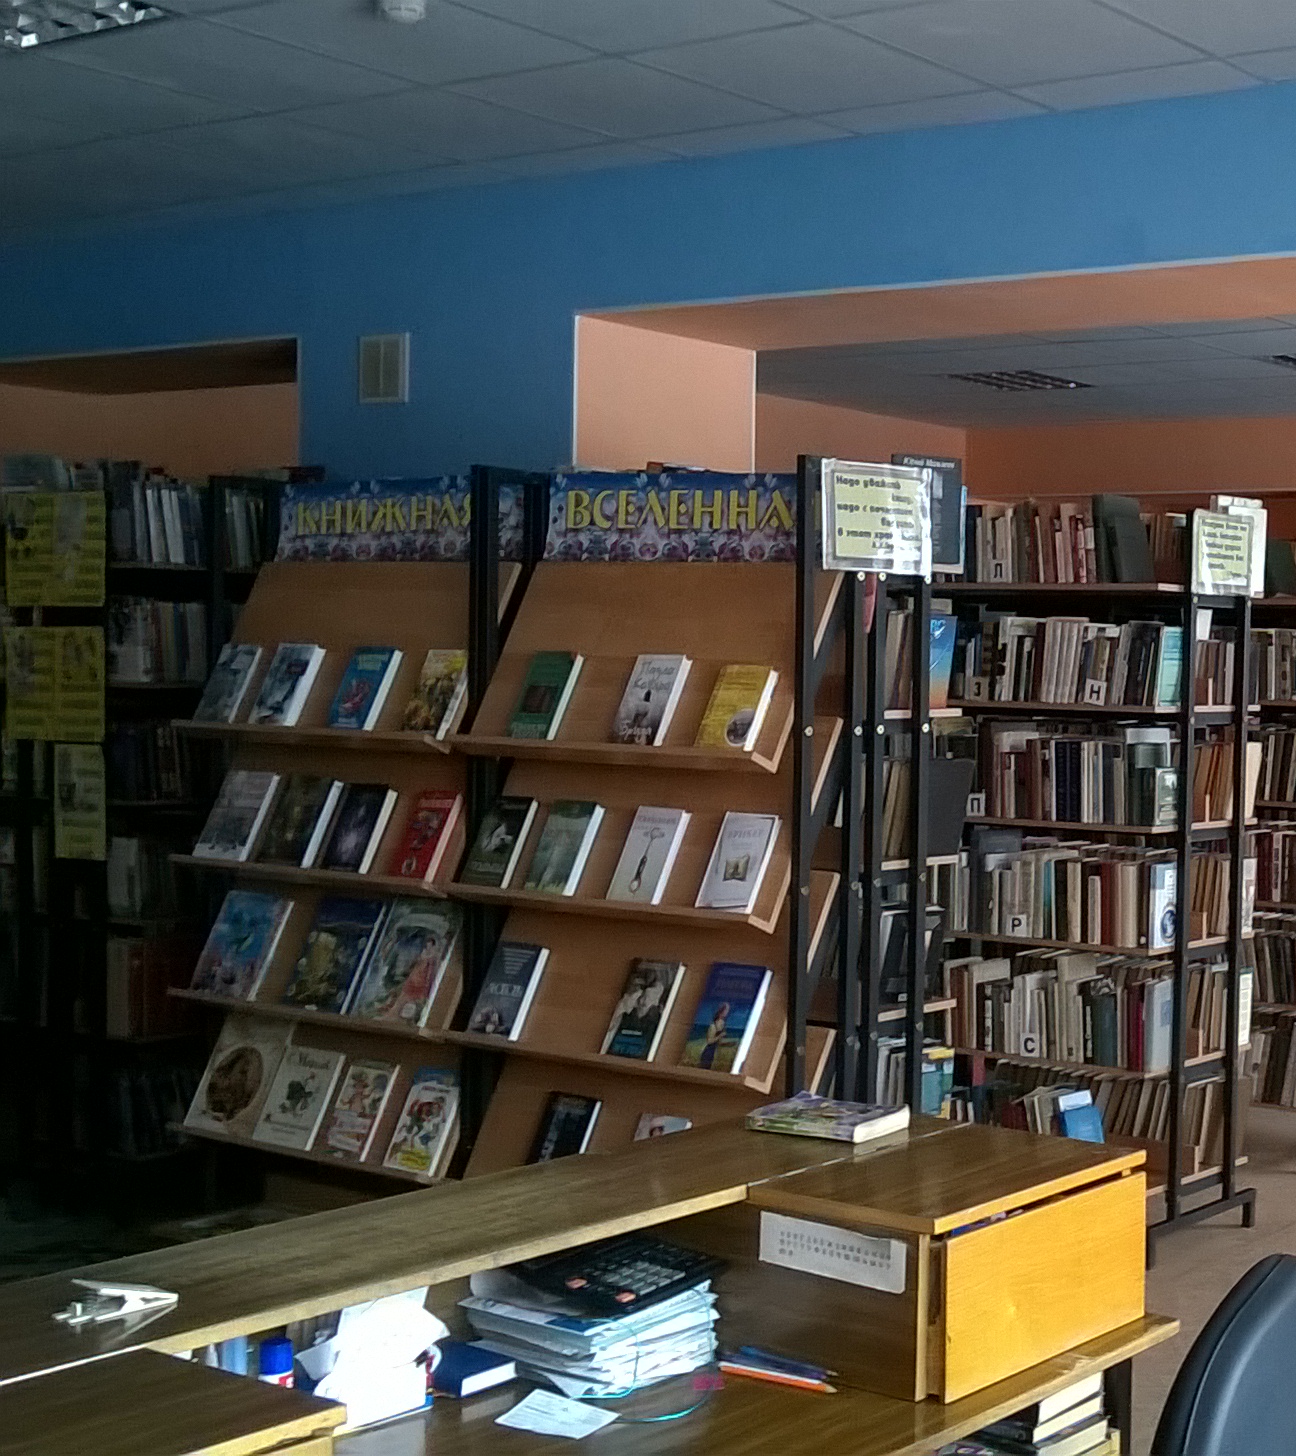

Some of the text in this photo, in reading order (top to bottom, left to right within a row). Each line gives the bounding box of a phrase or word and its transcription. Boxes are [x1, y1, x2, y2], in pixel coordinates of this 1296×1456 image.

[566, 488, 821, 531] ВСЕЛЕННА
[994, 563, 1003, 578] Л
[1090, 684, 1101, 700] Н
[970, 797, 981, 814] П
[1011, 917, 1022, 933] Р
[1023, 1037, 1036, 1054] С
